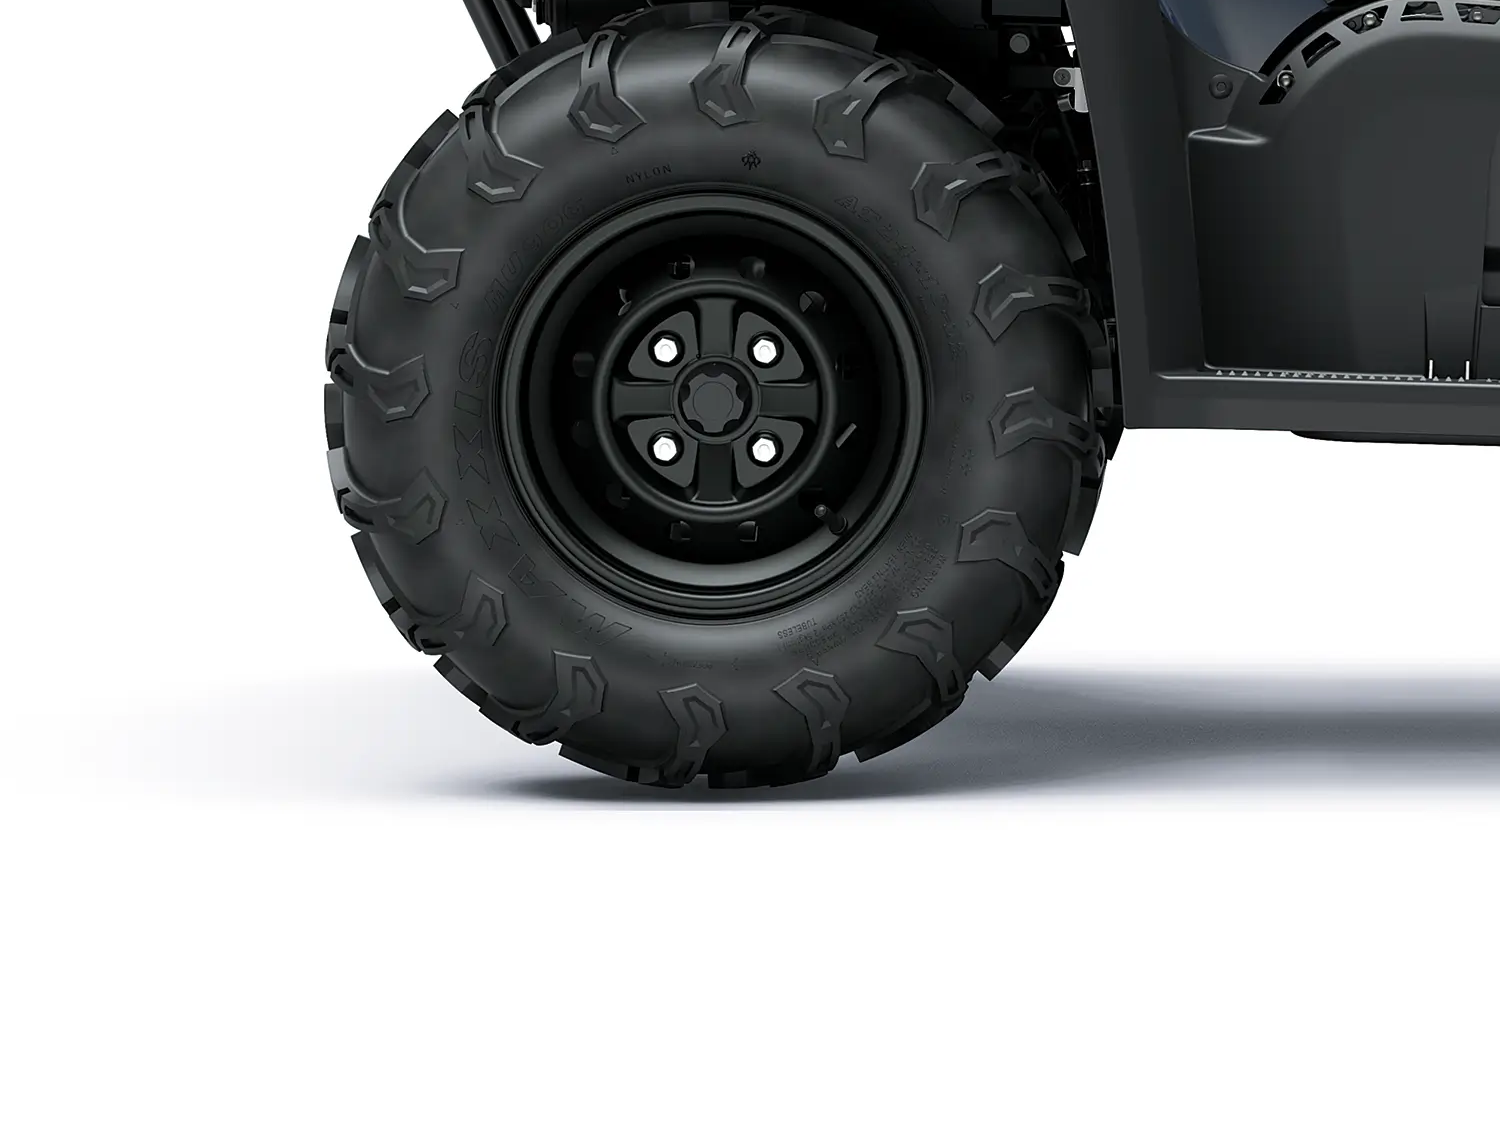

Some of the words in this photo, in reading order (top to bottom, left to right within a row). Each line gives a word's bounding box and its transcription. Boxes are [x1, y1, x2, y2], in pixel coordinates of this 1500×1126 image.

[625, 163, 672, 184] NYLON
[453, 330, 632, 646] MAXXIS
[776, 617, 818, 640] TUBELESS
